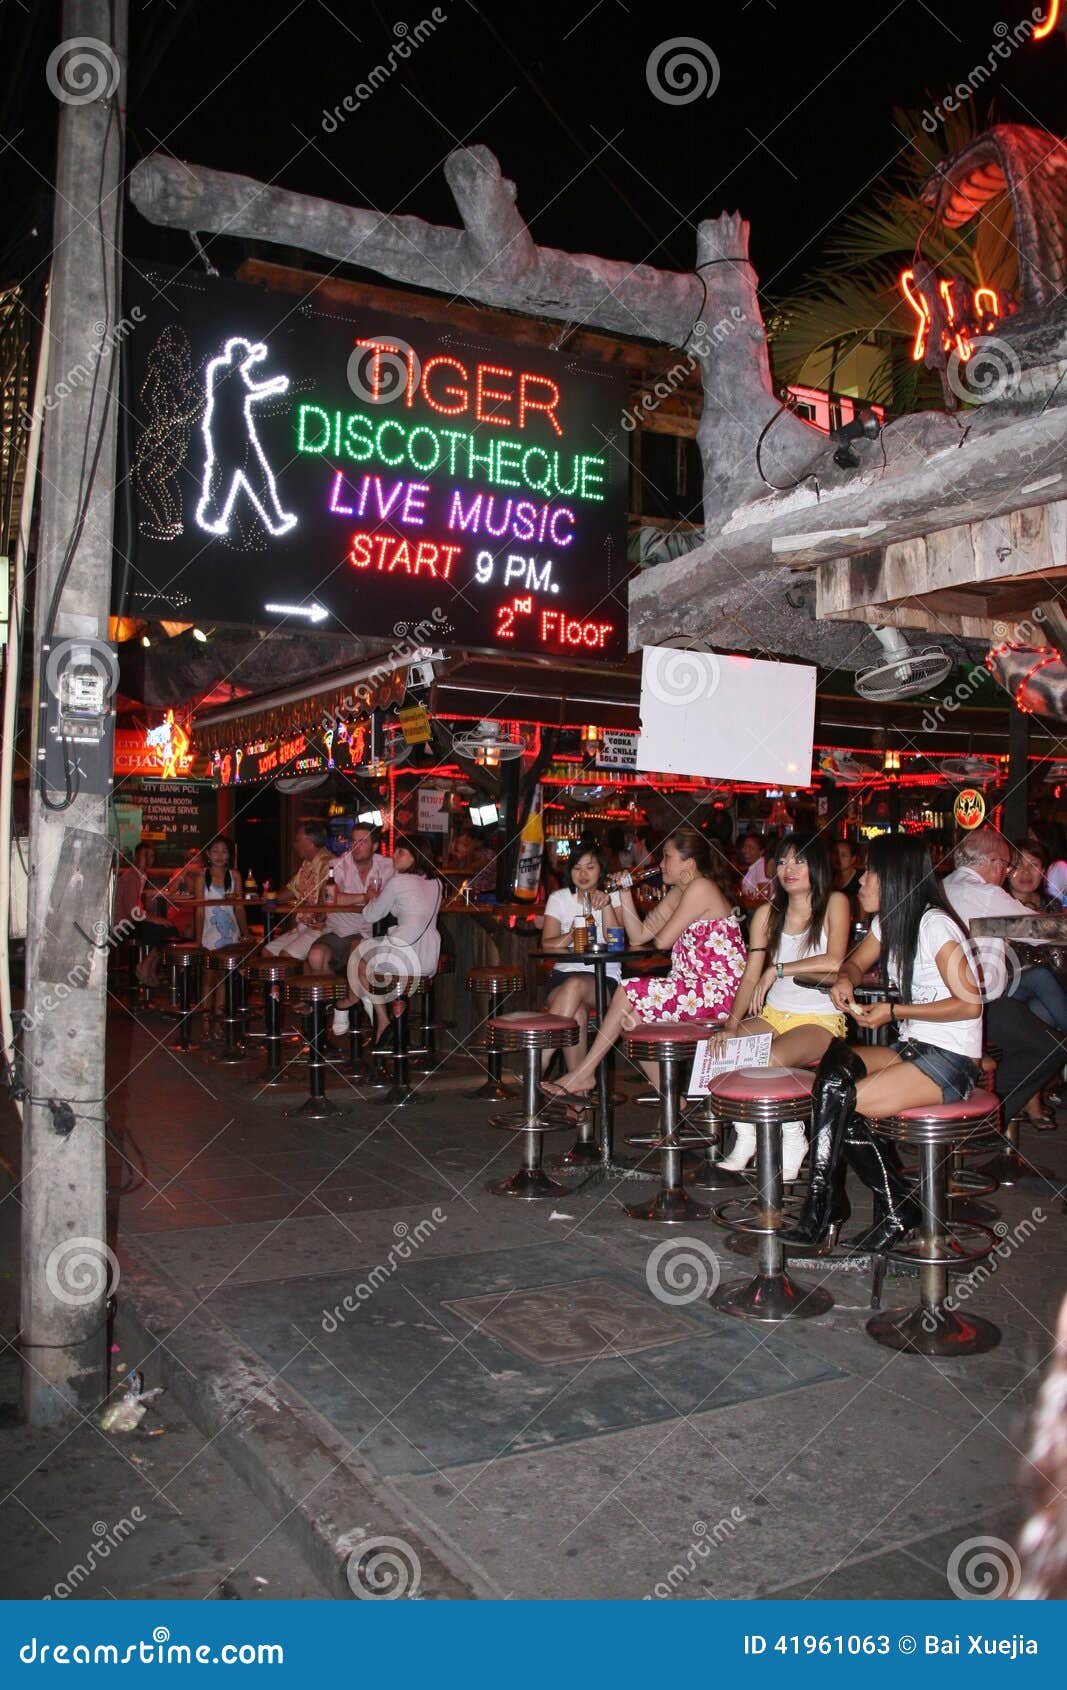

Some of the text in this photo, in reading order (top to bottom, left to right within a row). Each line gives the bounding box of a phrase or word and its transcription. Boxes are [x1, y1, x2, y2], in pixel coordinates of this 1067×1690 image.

[356, 338, 563, 435] TIGER
[297, 404, 605, 501] DISCOTHEQUE
[330, 471, 577, 546] LIVE MUSIC
[350, 534, 559, 593] START 9 PM.
[541, 610, 614, 648] Floor
[116, 754, 190, 768] CHANE
[608, 738, 632, 746] VODKA
[612, 748, 637, 756] CHILLE
